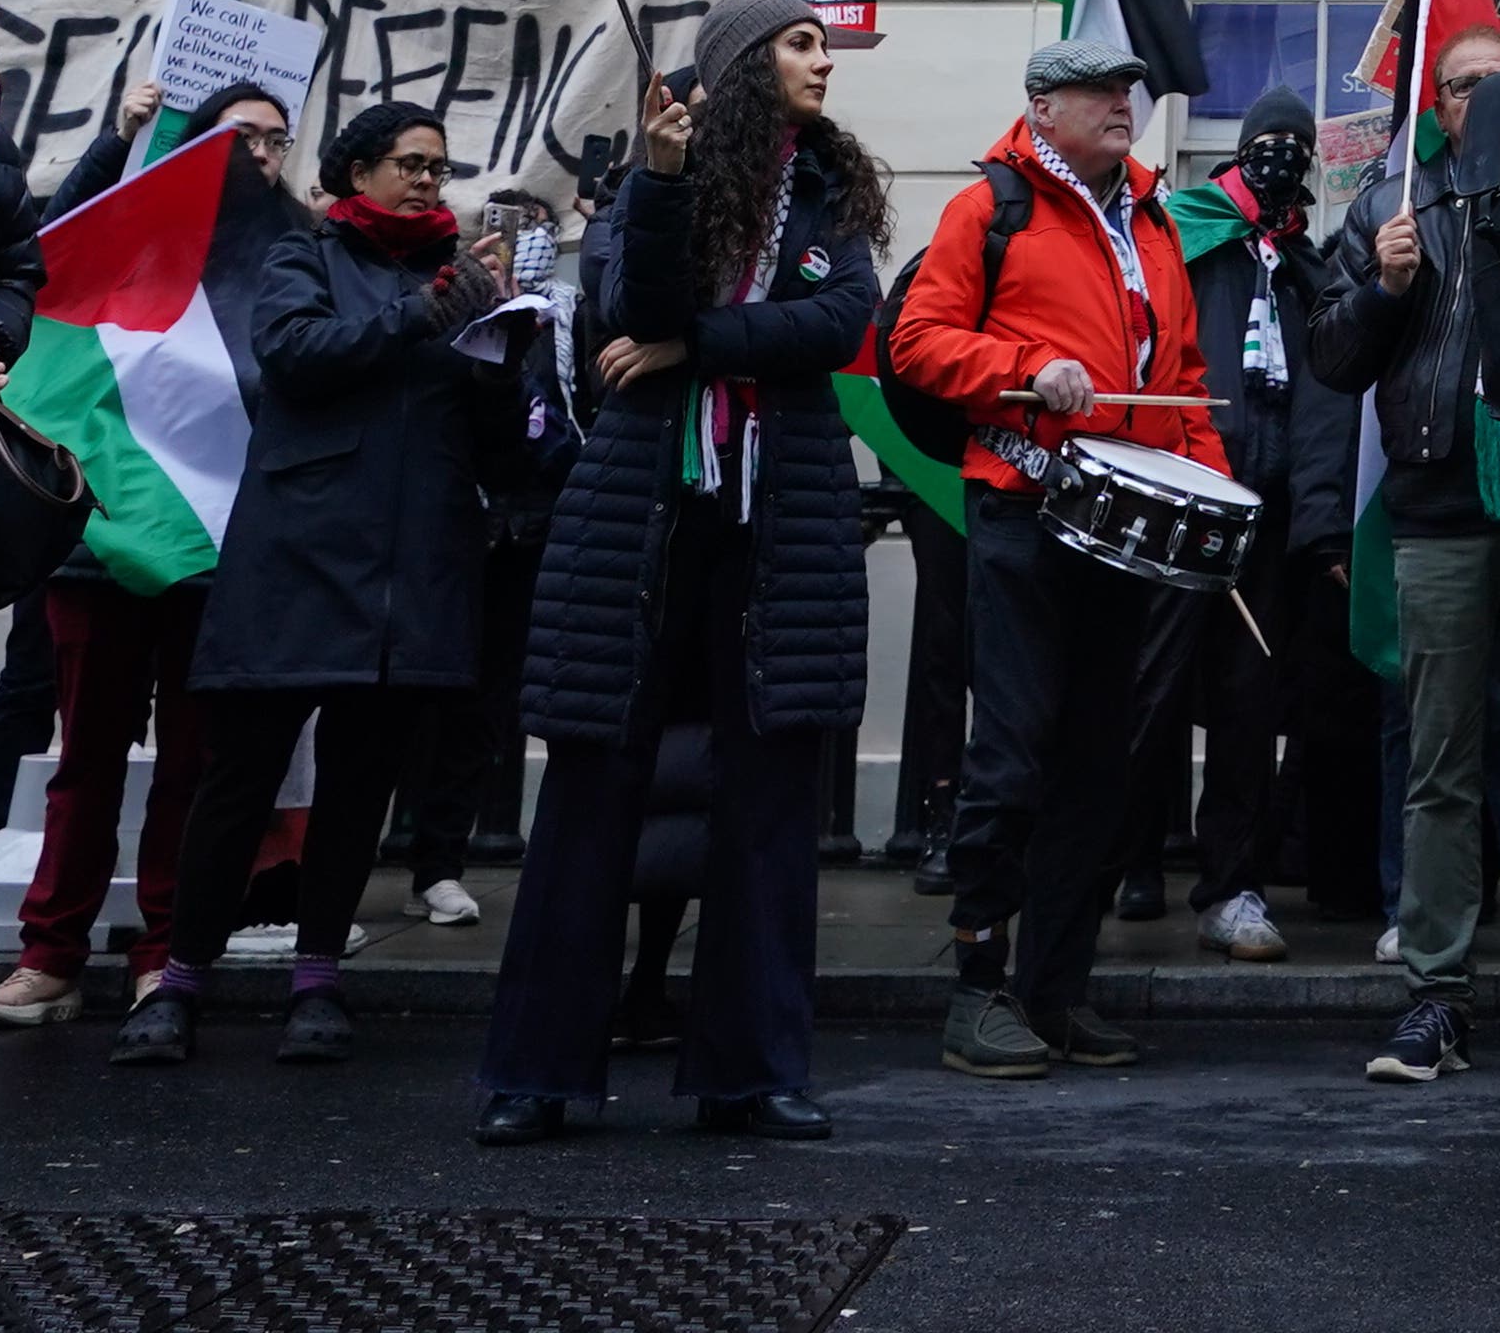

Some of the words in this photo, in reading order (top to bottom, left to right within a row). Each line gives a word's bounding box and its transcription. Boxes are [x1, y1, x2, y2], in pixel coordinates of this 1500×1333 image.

[219, 8, 250, 28] call
[252, 19, 267, 34] it
[814, 5, 865, 26] CIALIST
[178, 15, 259, 52] Genocide
[172, 35, 259, 76] deliberately
